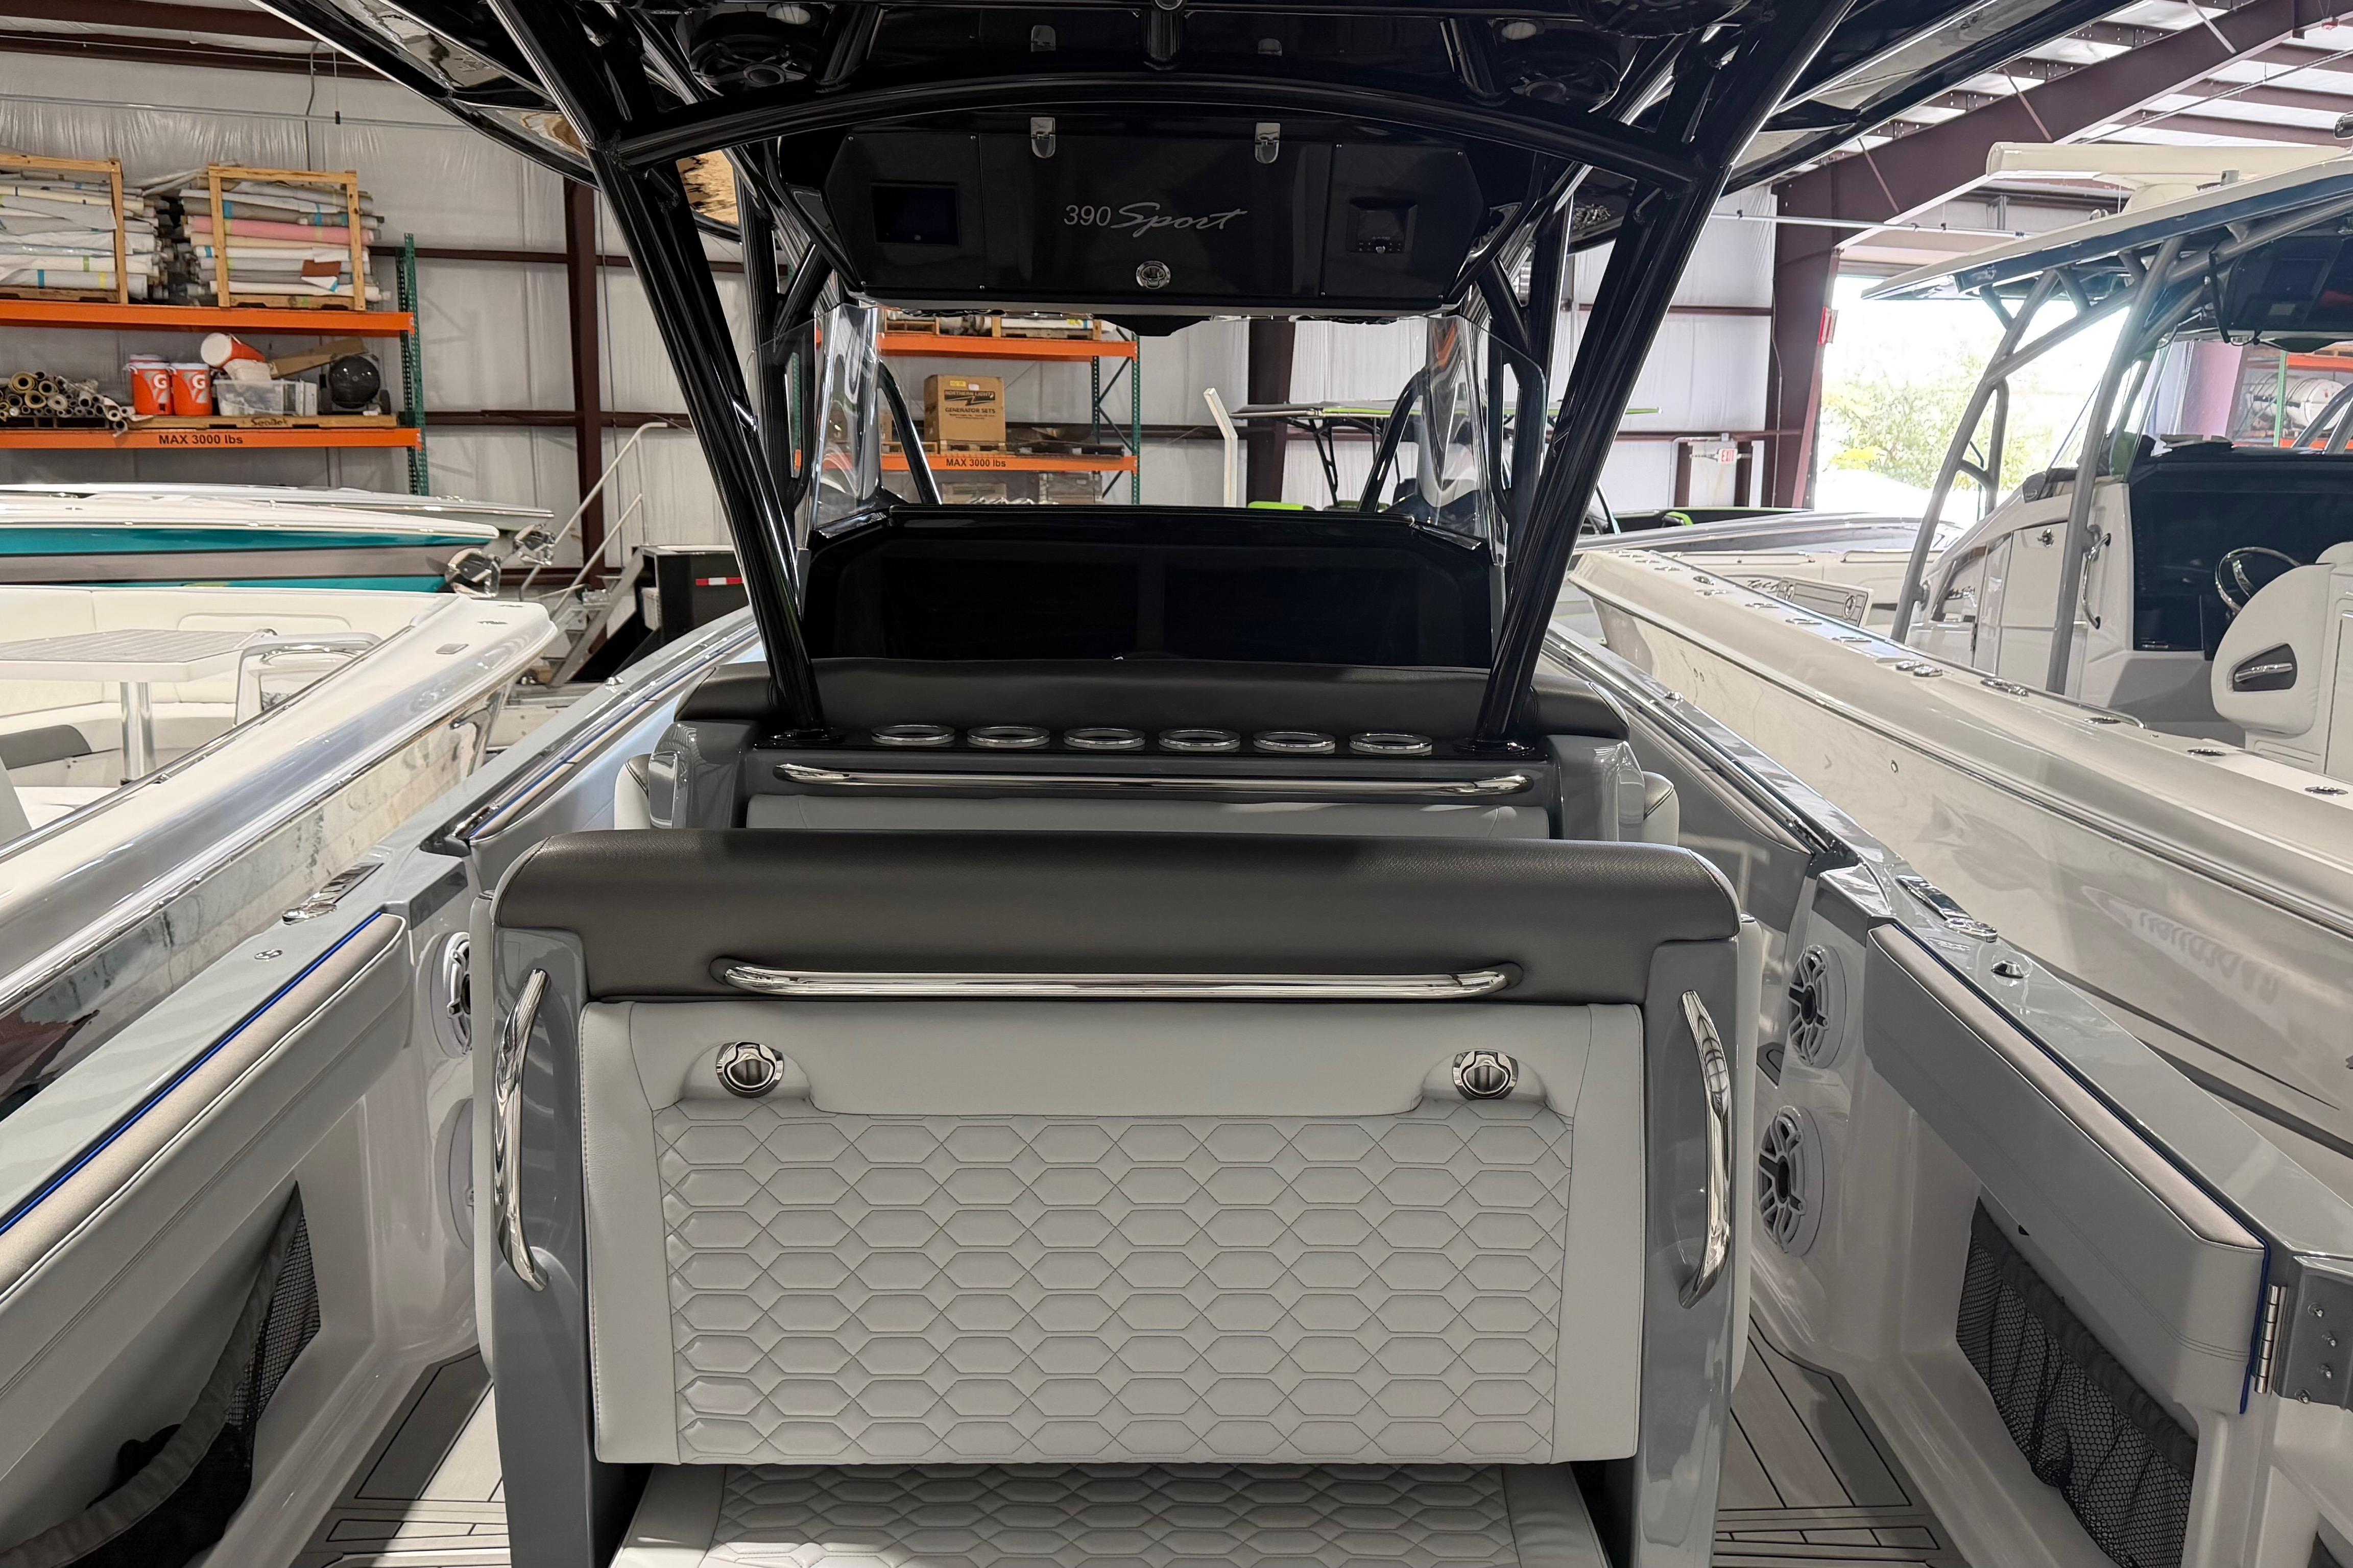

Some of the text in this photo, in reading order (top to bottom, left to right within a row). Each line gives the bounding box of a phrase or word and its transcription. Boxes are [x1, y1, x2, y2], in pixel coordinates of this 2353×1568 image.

[1064, 202, 1247, 237] 390 Sport
[154, 374, 167, 389] G
[193, 374, 206, 390] G
[159, 434, 243, 444] MAX 3000 lbs
[1721, 449, 1735, 462] EXIT
[946, 459, 1006, 467] MAX 3000 lbs
